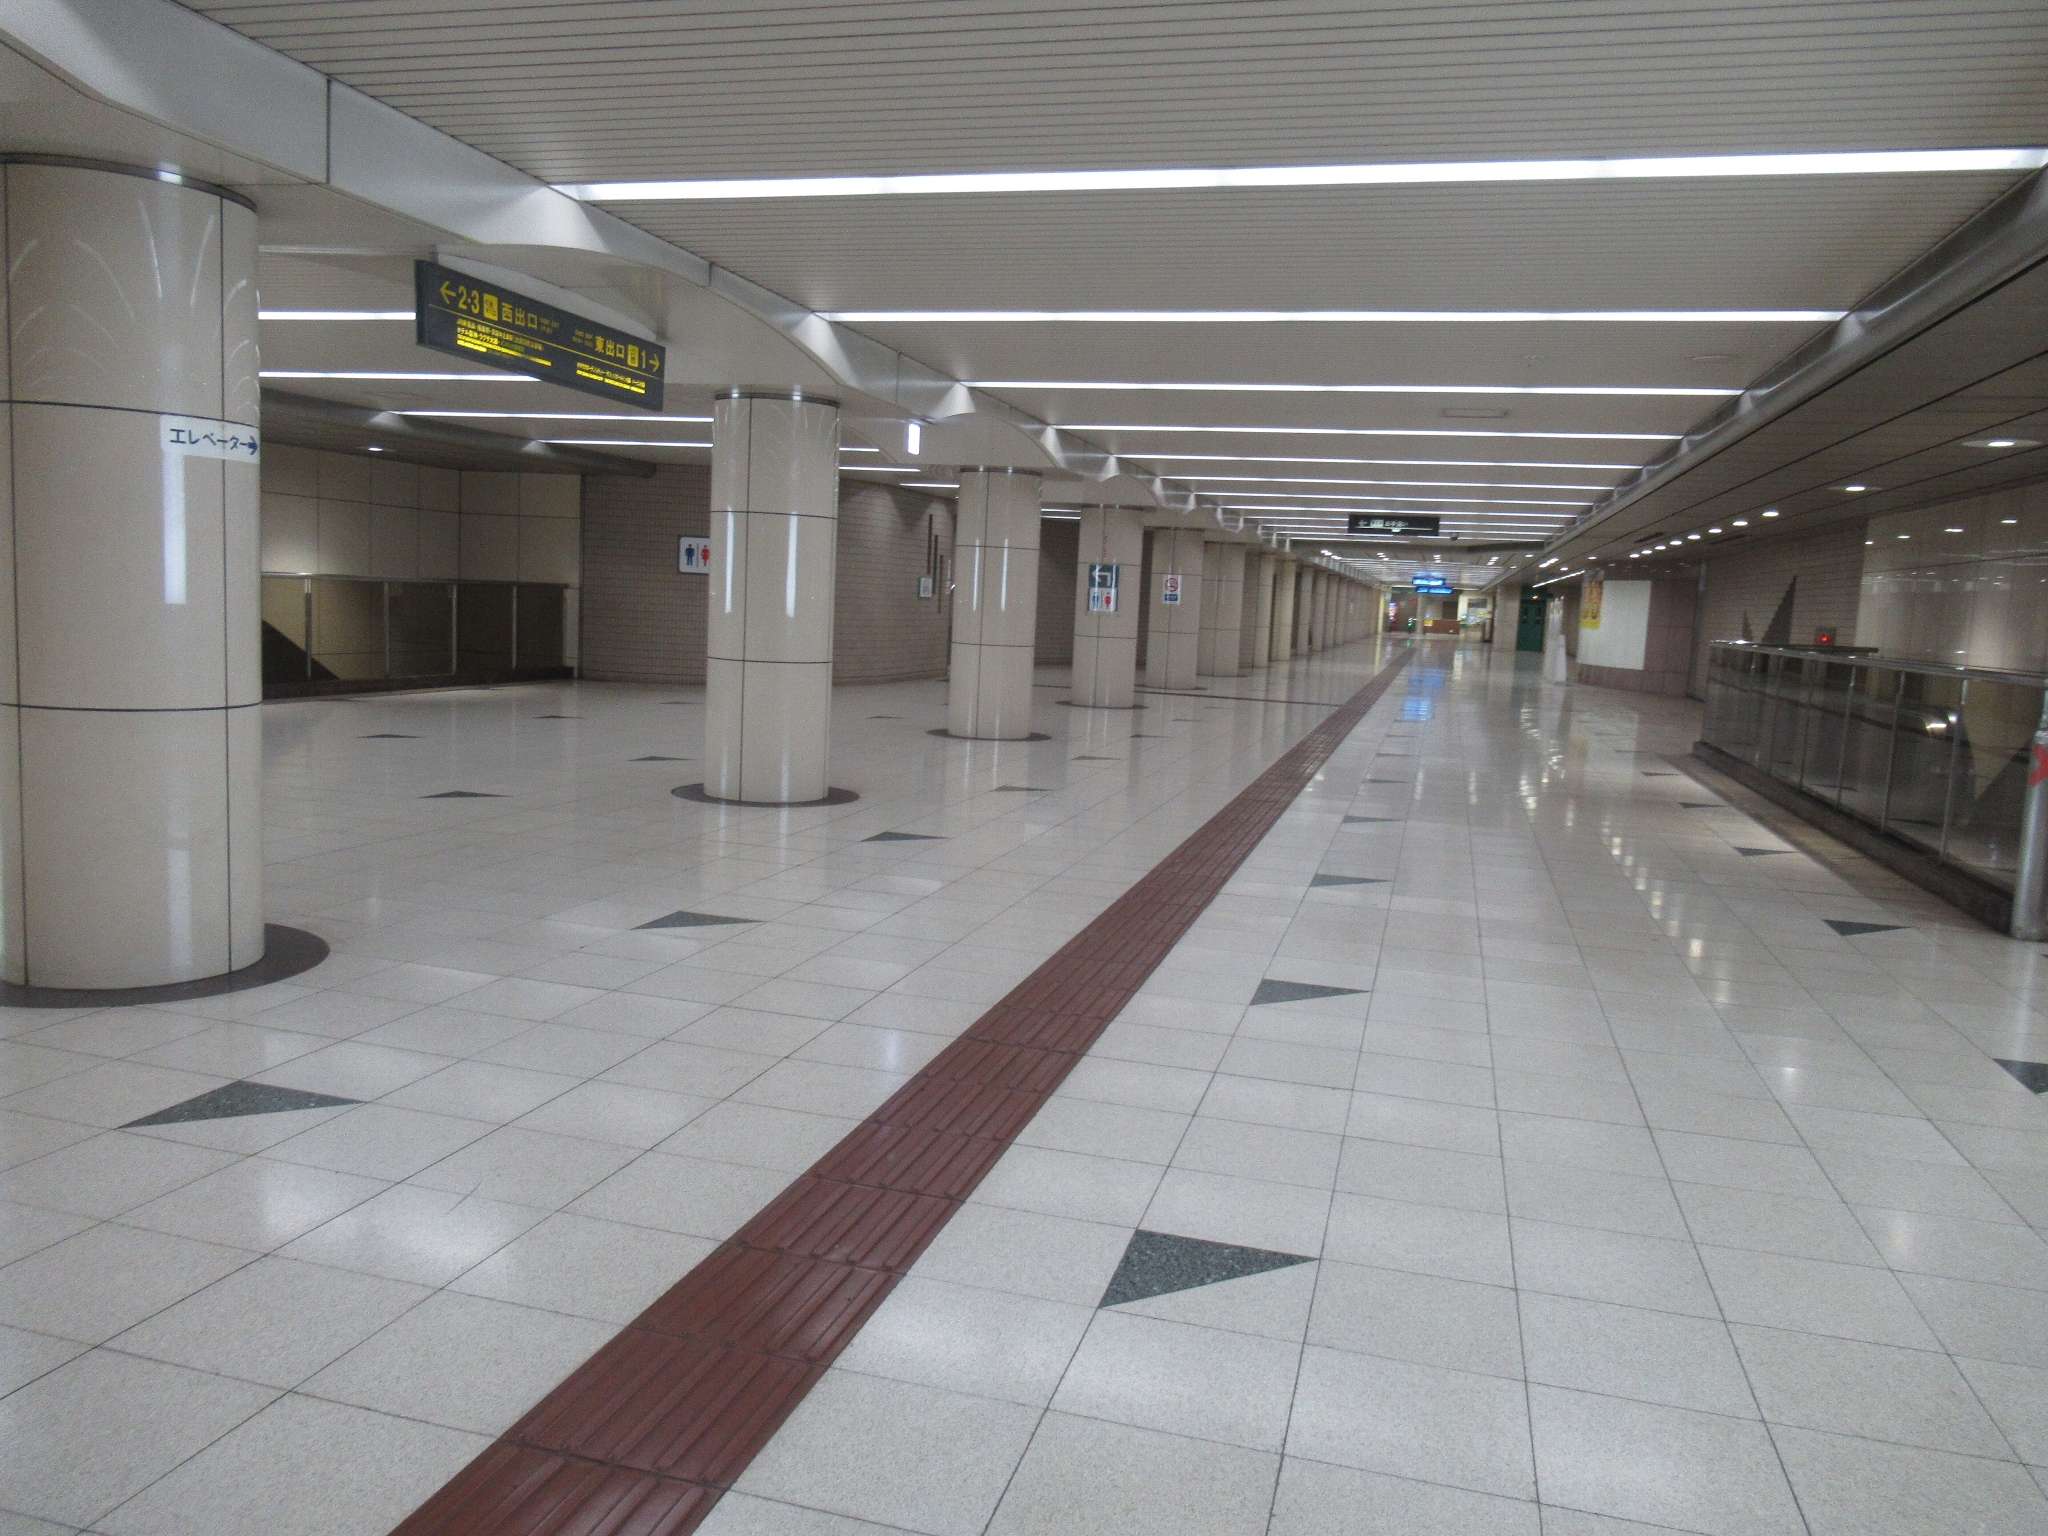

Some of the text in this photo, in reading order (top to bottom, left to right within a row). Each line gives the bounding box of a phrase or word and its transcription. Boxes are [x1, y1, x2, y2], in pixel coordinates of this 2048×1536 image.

[501, 302, 538, 330] 西出口
[594, 335, 626, 358] 東出口
